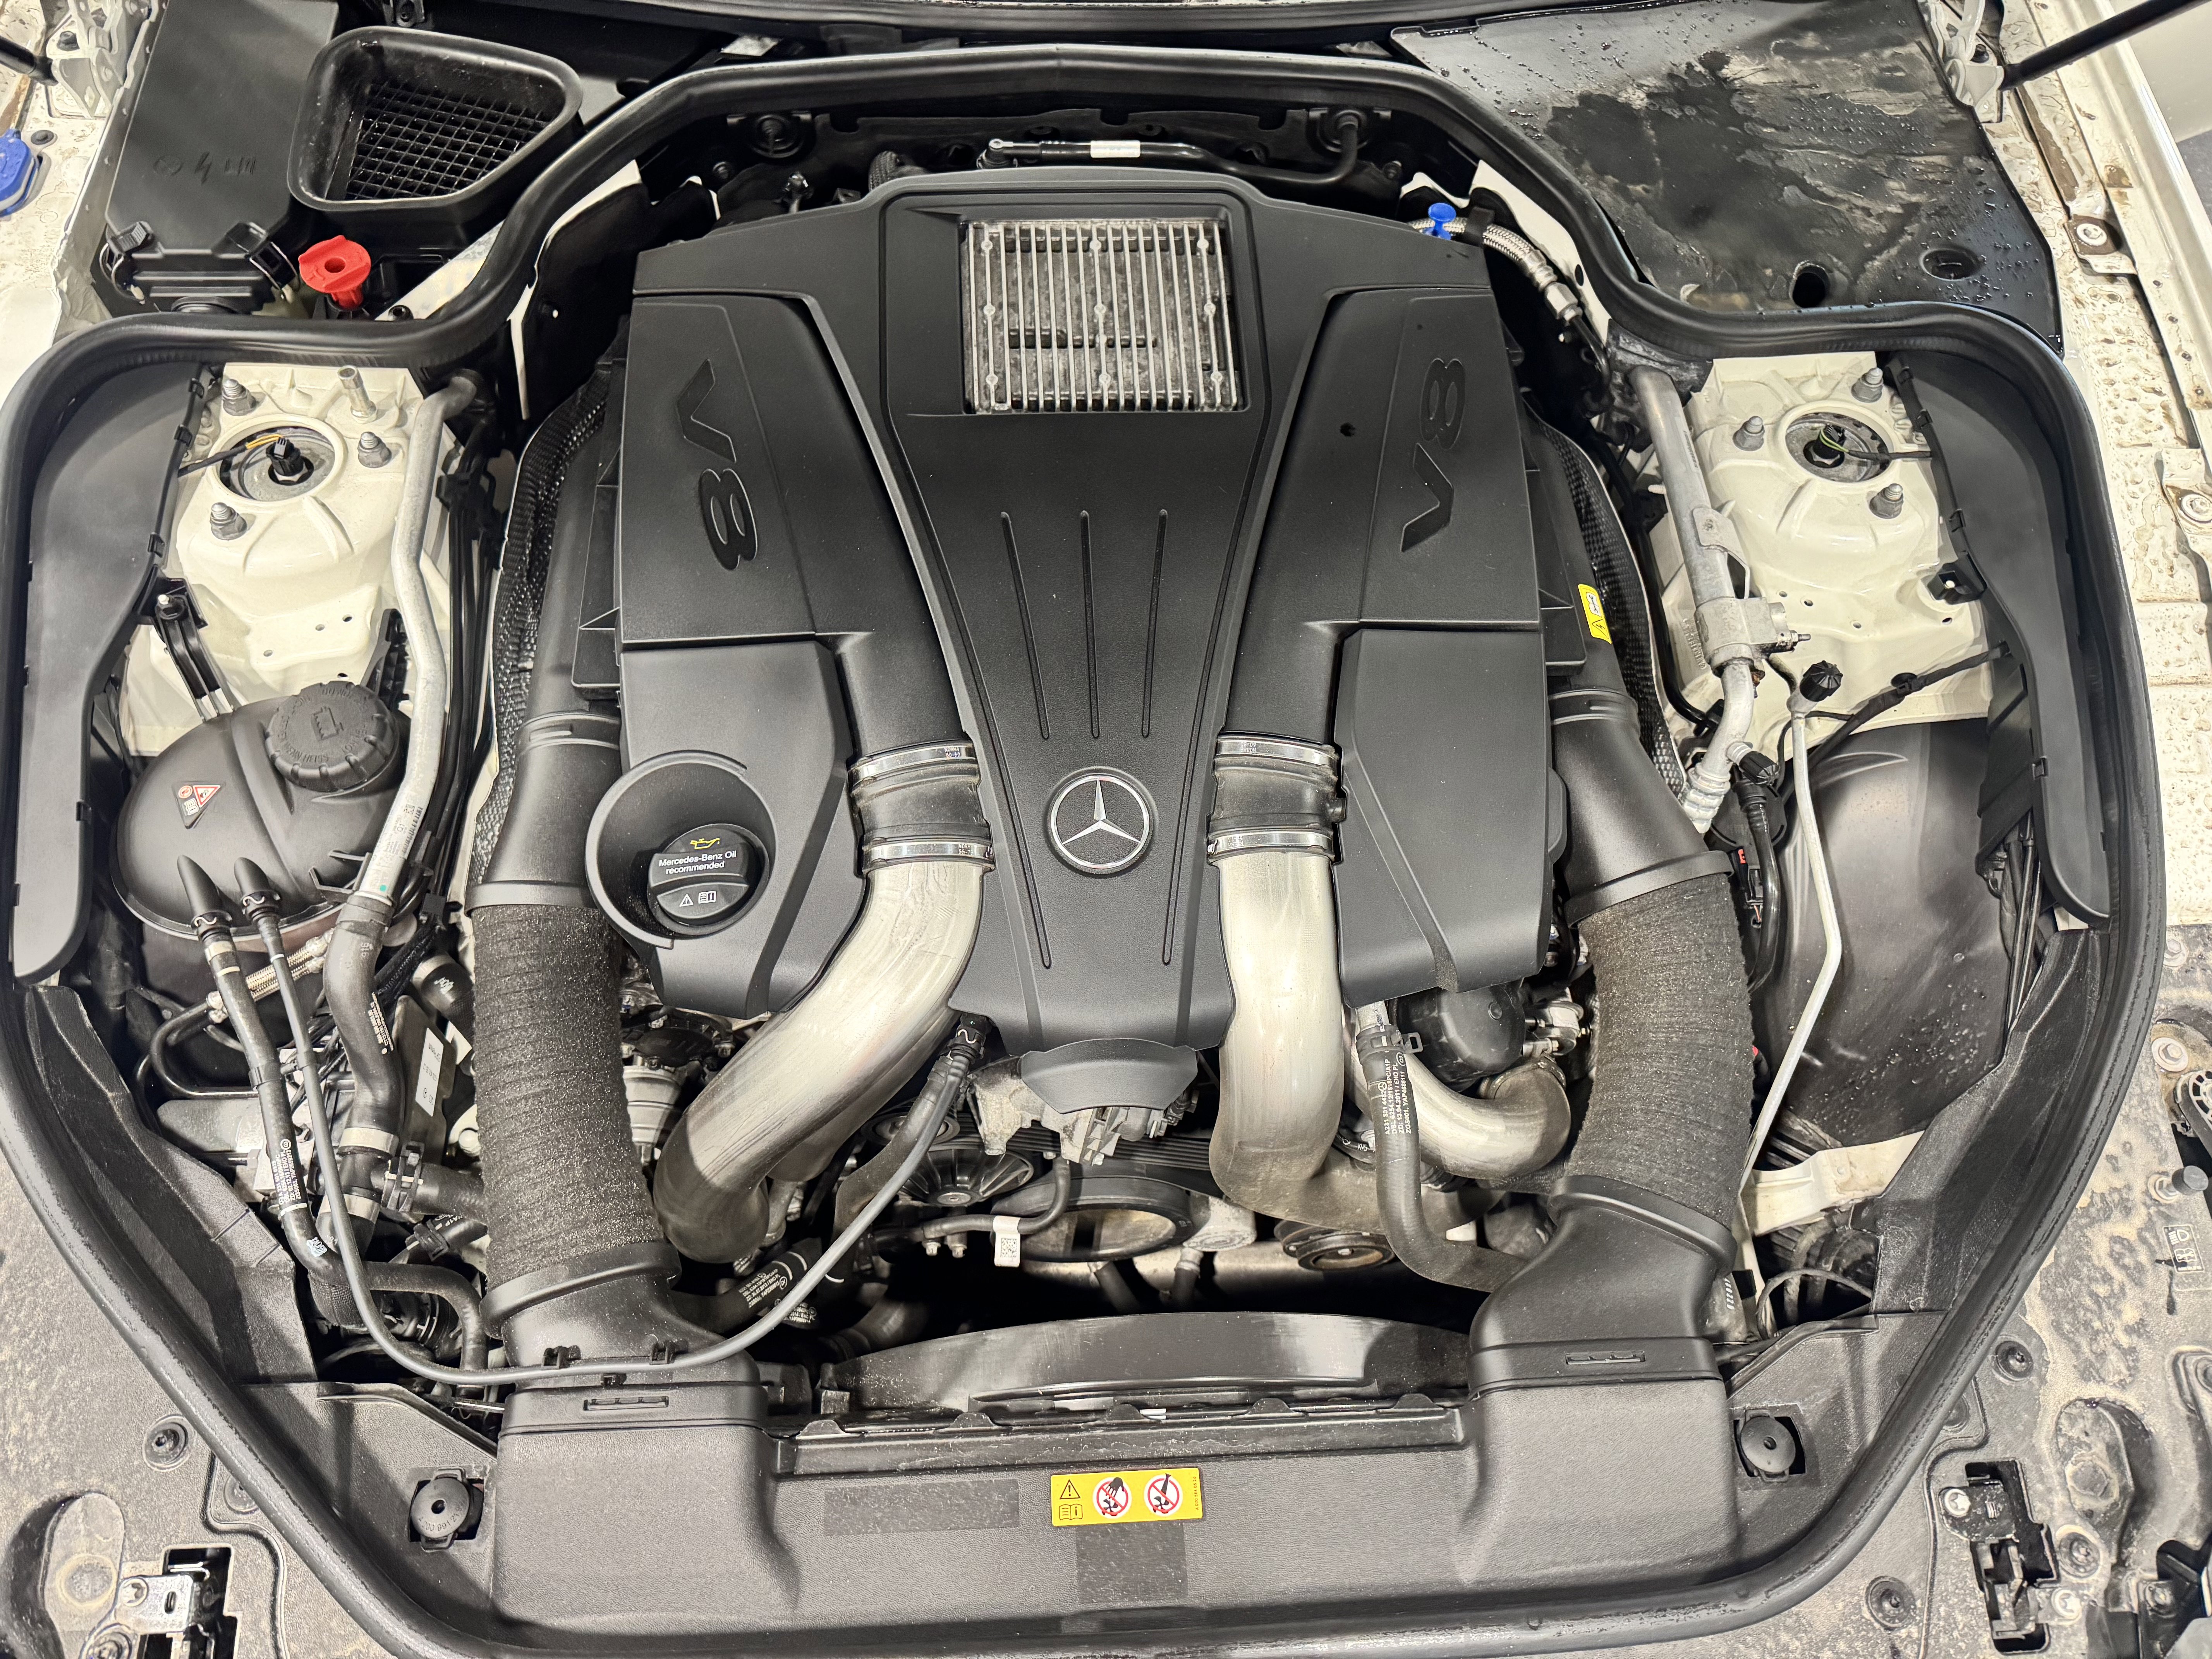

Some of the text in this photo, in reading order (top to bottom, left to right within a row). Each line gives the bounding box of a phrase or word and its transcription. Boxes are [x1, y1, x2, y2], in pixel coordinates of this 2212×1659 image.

[677, 358, 758, 570] V8
[1400, 357, 1466, 553] V8
[658, 850, 737, 867] Mercedes-Benz Oil
[666, 861, 725, 874] recommended
[1392, 1062, 1398, 1070] PL
[1394, 1089, 1403, 1120] 13.04.2011
